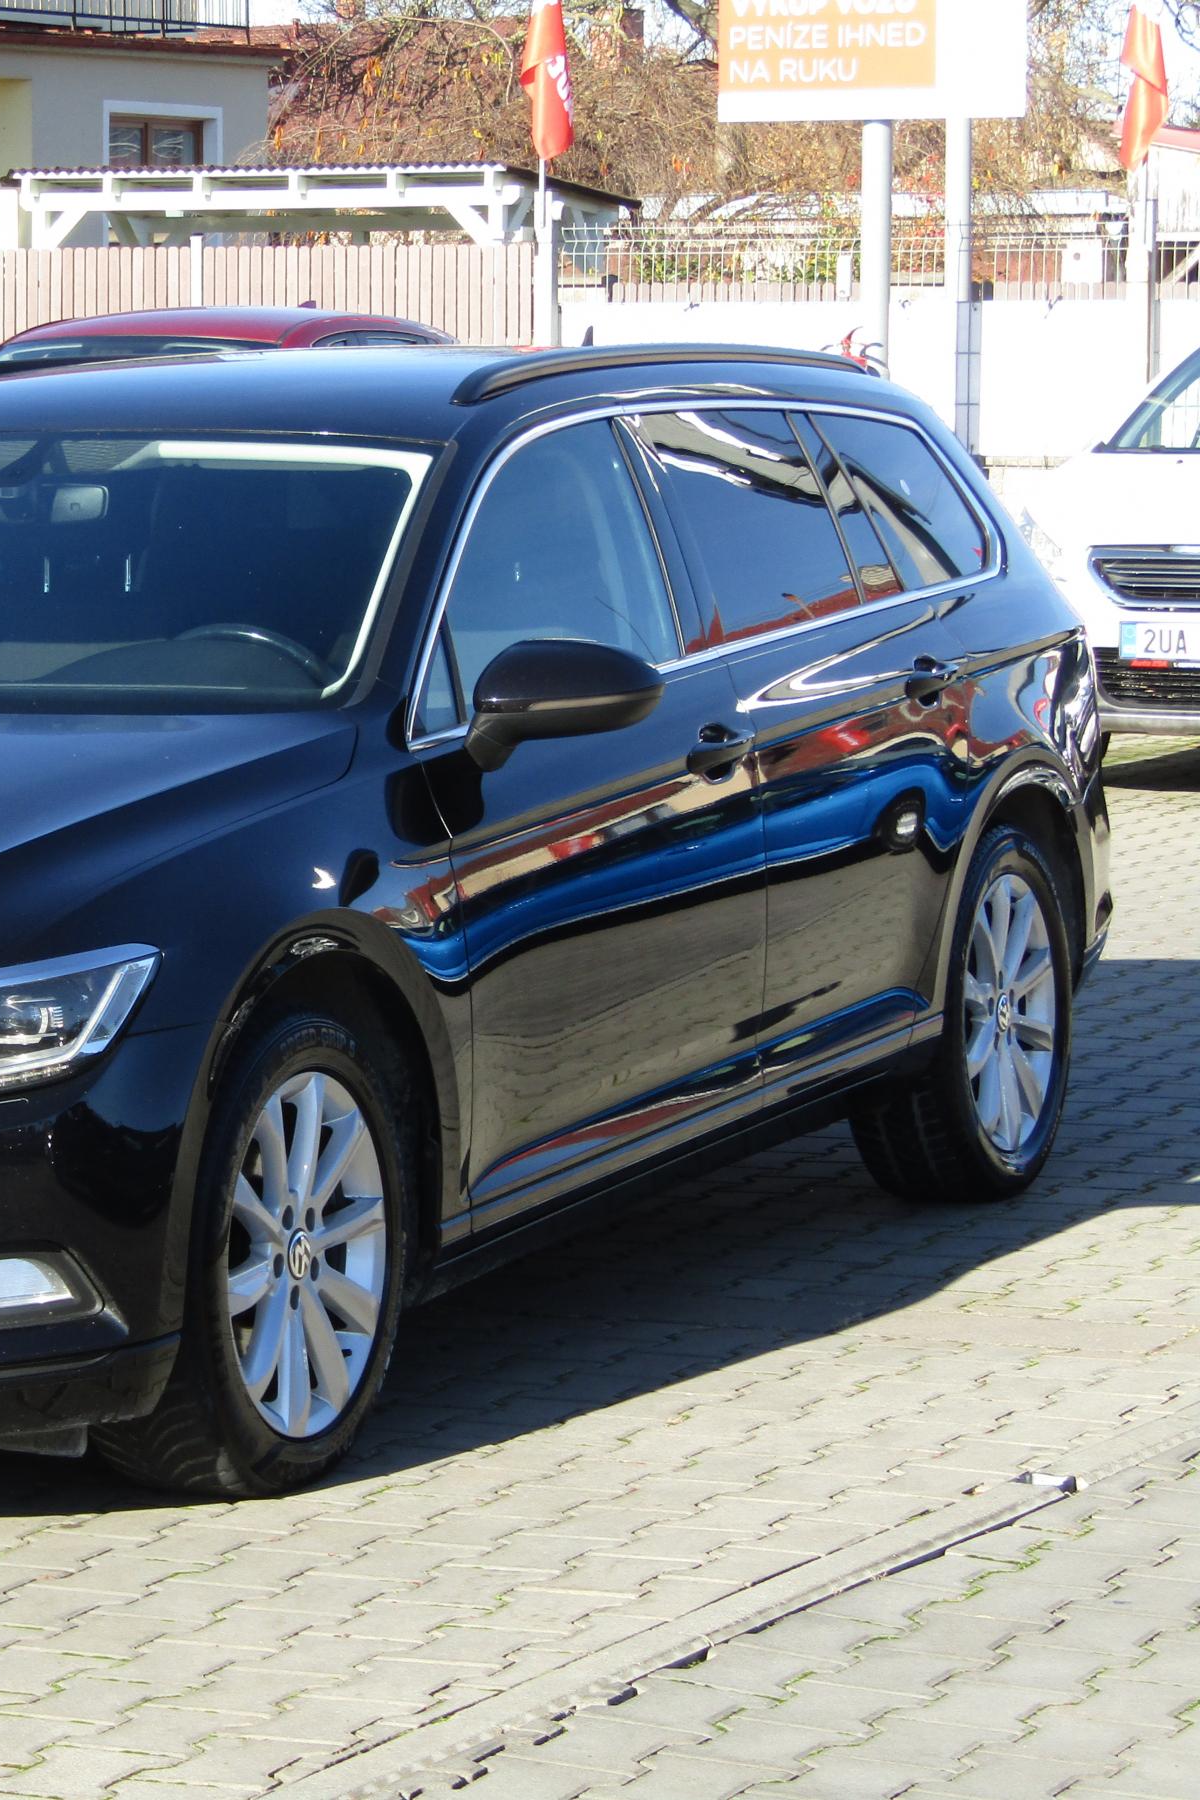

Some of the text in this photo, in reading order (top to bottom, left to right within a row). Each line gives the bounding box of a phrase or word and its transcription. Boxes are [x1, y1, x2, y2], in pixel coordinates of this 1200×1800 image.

[729, 21, 927, 50] PENÍZE IHNED
[729, 58, 858, 83] NA RUKU
[1144, 629, 1187, 654] 2UA
